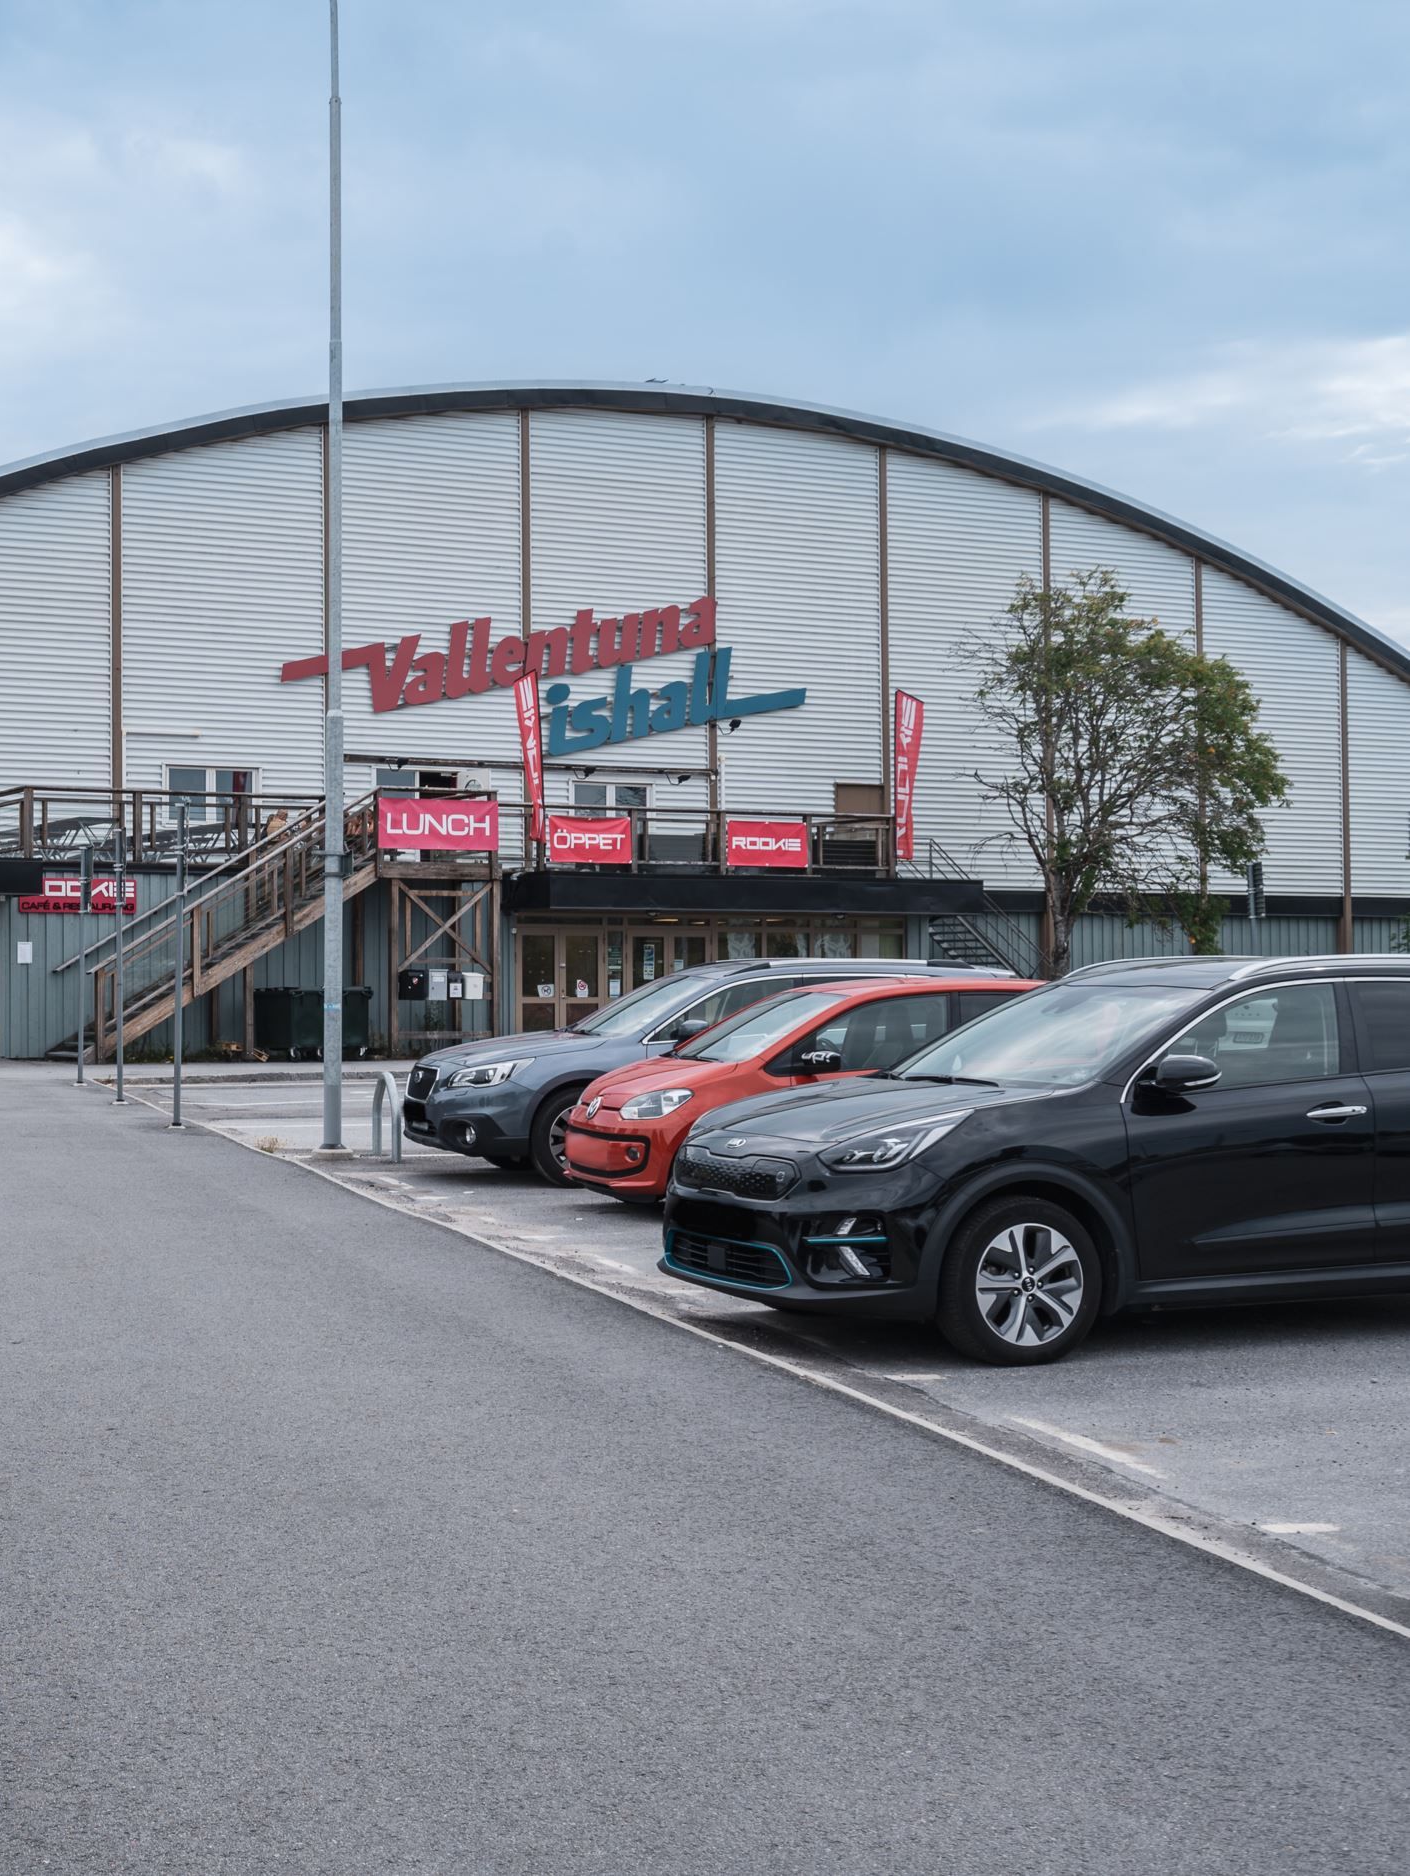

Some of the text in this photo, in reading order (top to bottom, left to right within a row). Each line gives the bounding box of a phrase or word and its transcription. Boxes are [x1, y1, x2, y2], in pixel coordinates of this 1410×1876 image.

[281, 596, 717, 713] Vallentuna
[547, 647, 807, 756] ishall
[386, 812, 490, 836] LUNCH
[554, 829, 626, 850] ÖPPET
[732, 836, 802, 852] ROOKIE
[21, 900, 50, 911] CAFÉ
[52, 902, 61, 910] &
